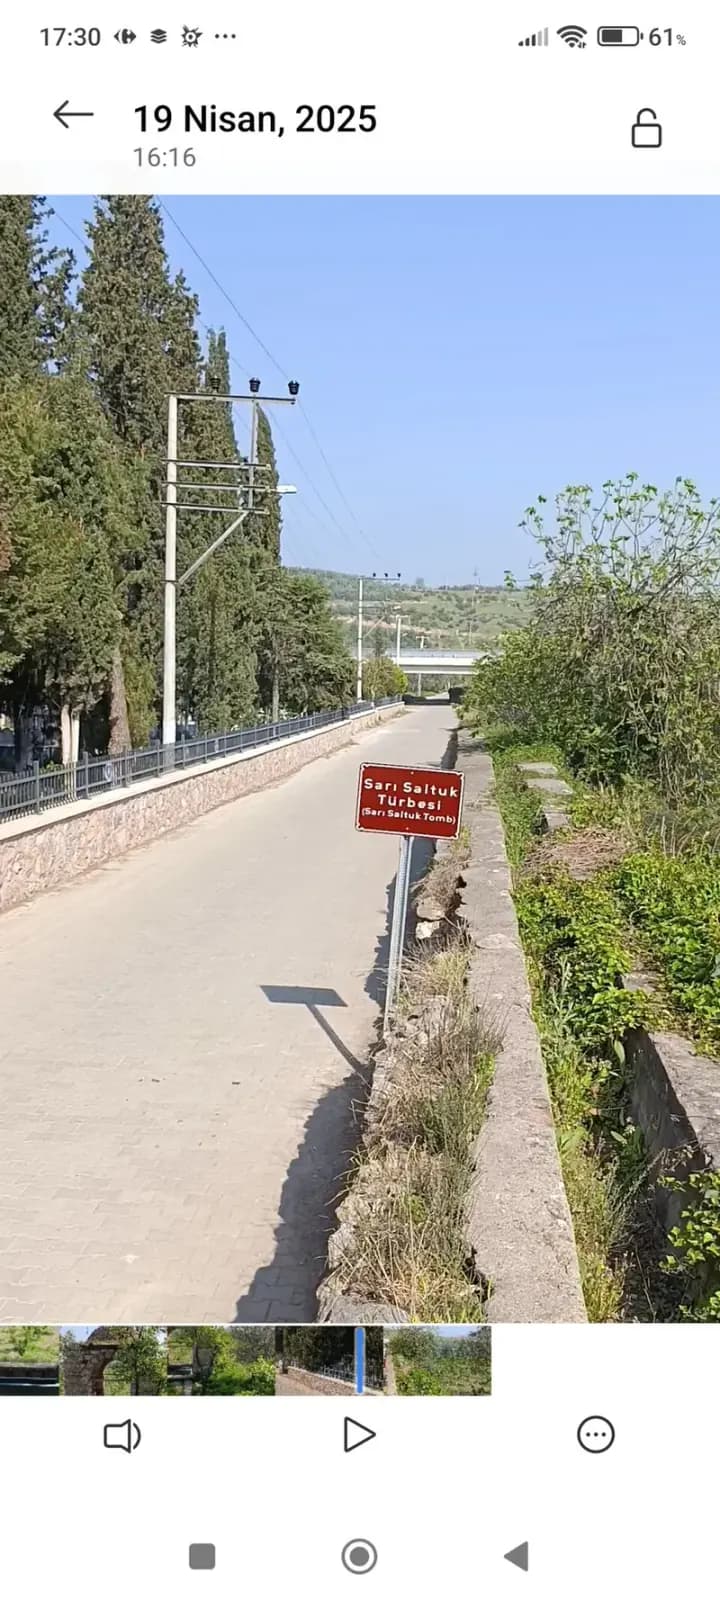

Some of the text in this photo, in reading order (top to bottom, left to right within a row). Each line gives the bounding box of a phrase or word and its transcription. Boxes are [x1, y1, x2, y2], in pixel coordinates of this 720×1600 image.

[363, 778, 459, 798] Sarı Saltuk
[377, 794, 441, 811] Türbesi
[387, 809, 421, 820] Saltuk
[423, 812, 456, 825] Tomb)
